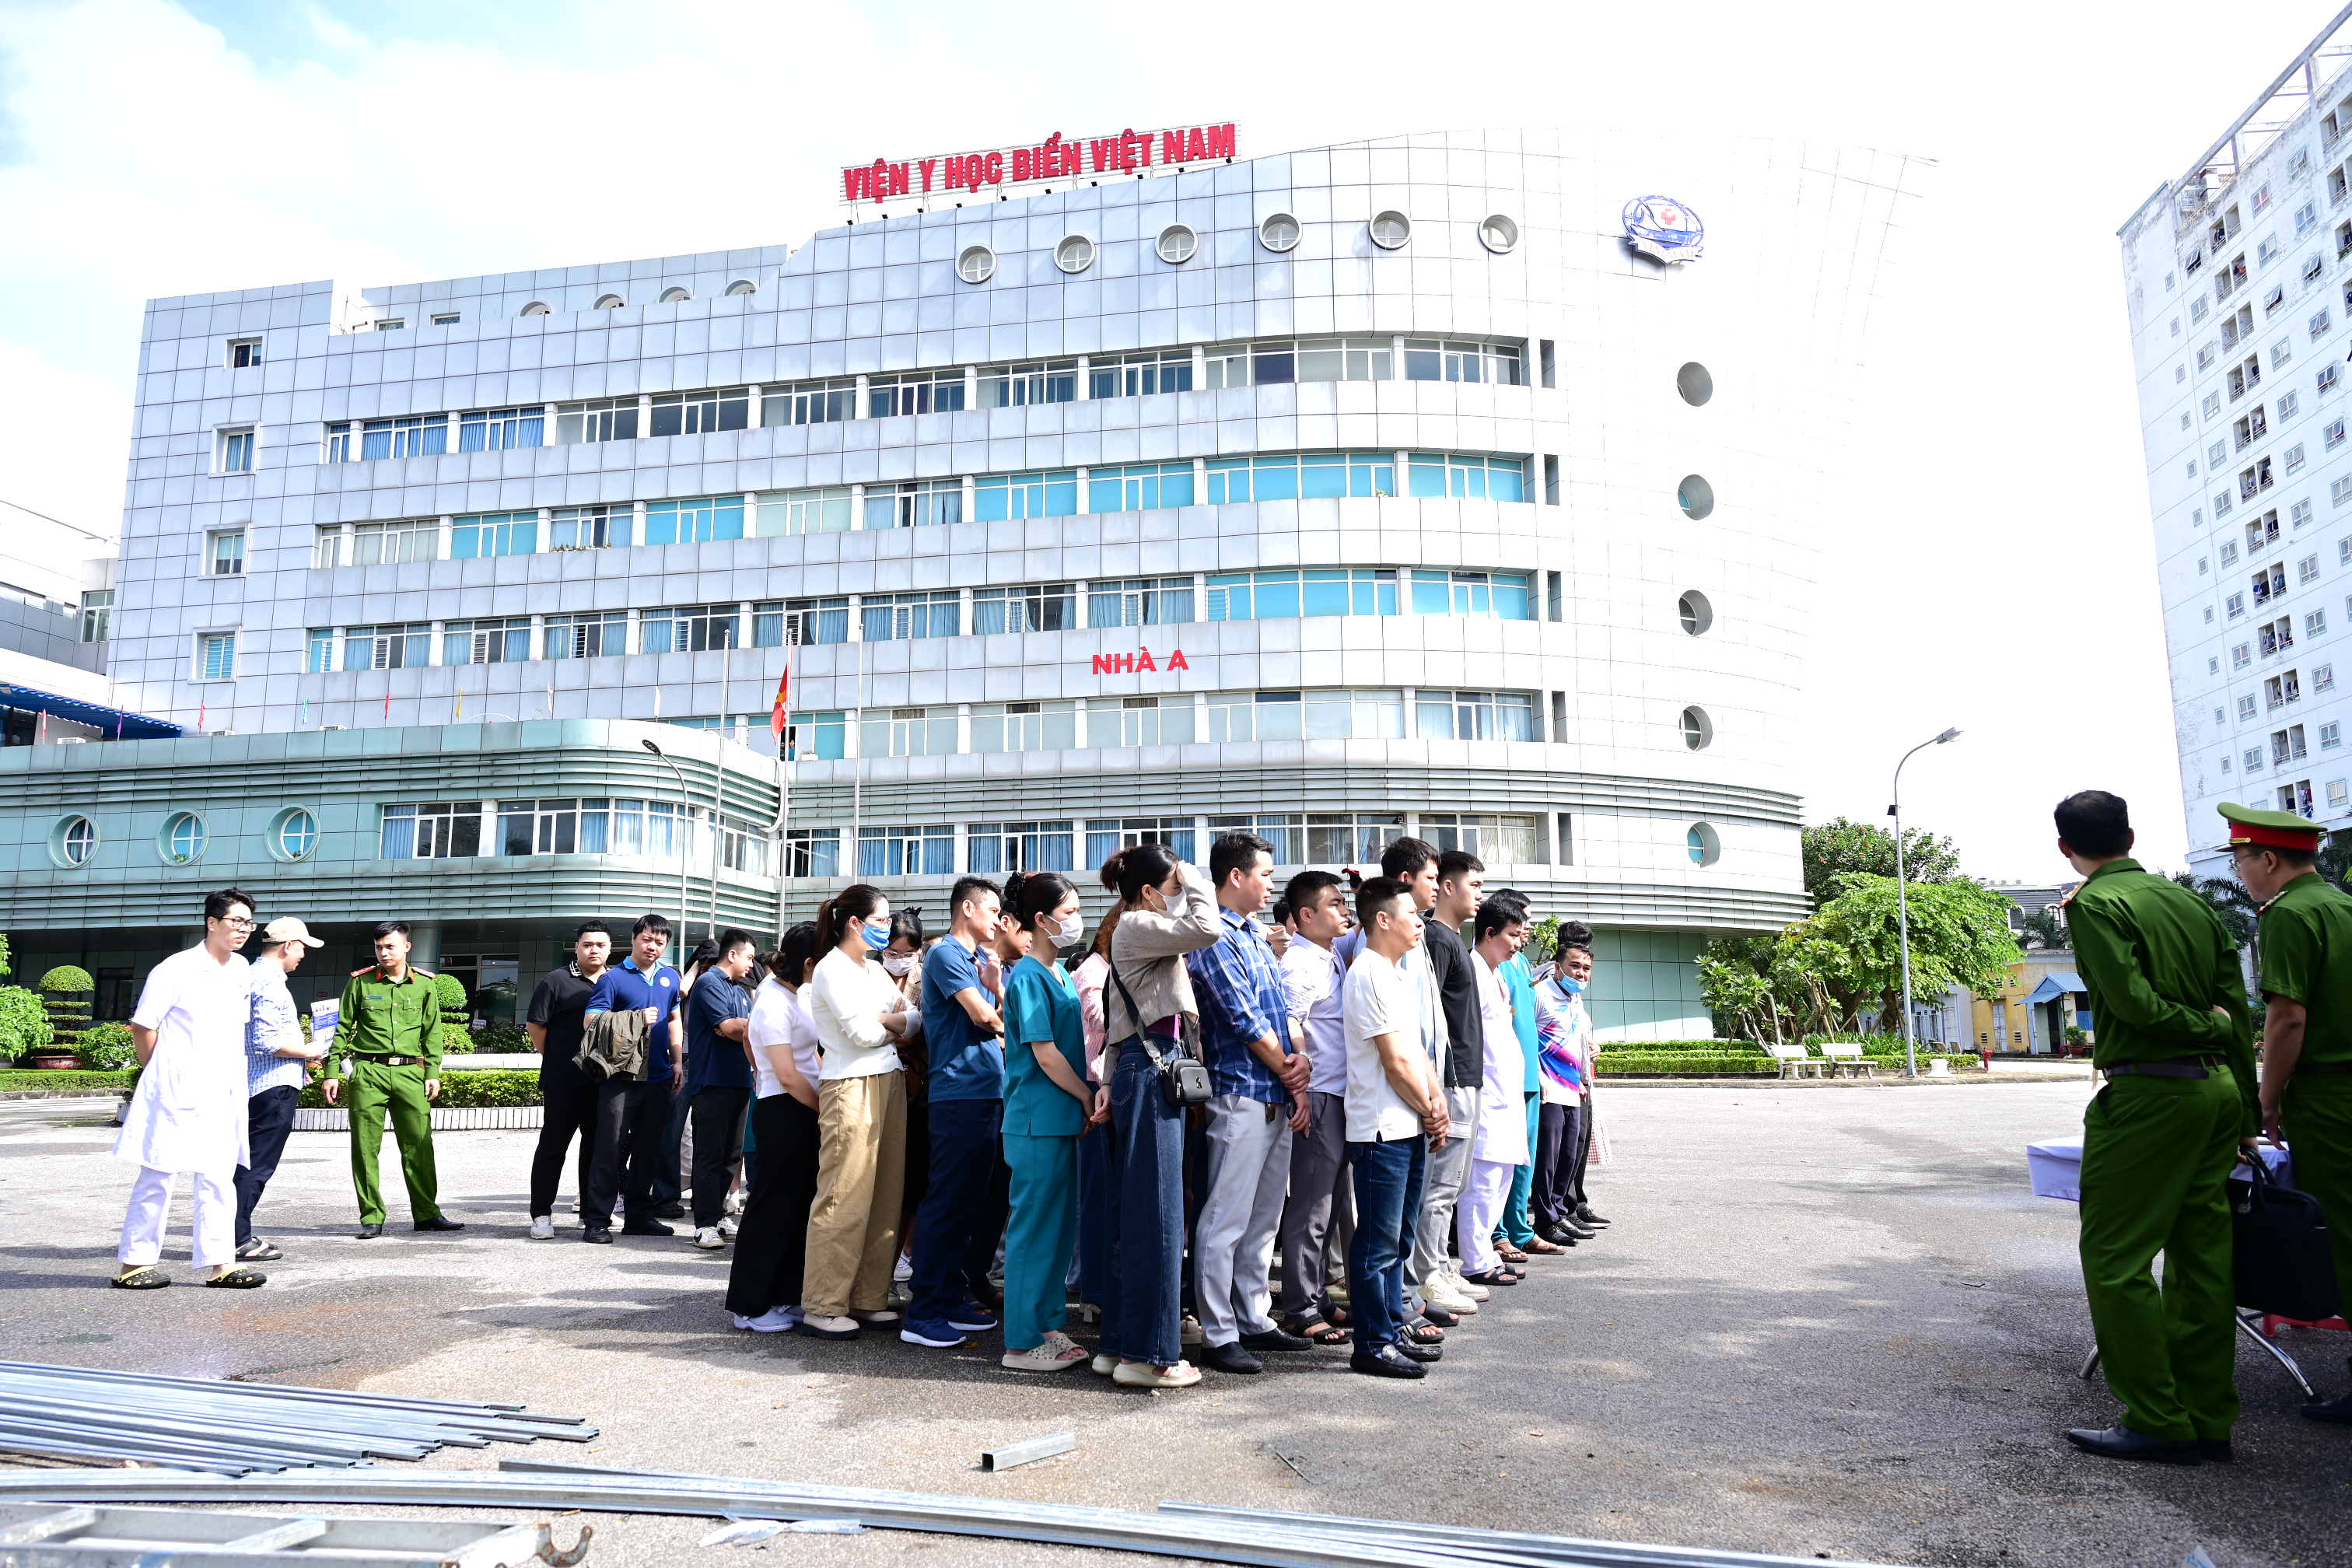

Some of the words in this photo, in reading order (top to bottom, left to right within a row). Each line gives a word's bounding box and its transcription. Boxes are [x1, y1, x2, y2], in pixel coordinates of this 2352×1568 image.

[844, 158, 909, 203] VIỆN
[918, 159, 936, 191] Y
[945, 152, 1003, 193] HỌC
[1012, 131, 1081, 181] BIỂN
[1090, 128, 1154, 175] VIỆT
[1163, 124, 1235, 163] NAM
[1093, 646, 1157, 674] NHÀ
[1167, 649, 1189, 671] A
